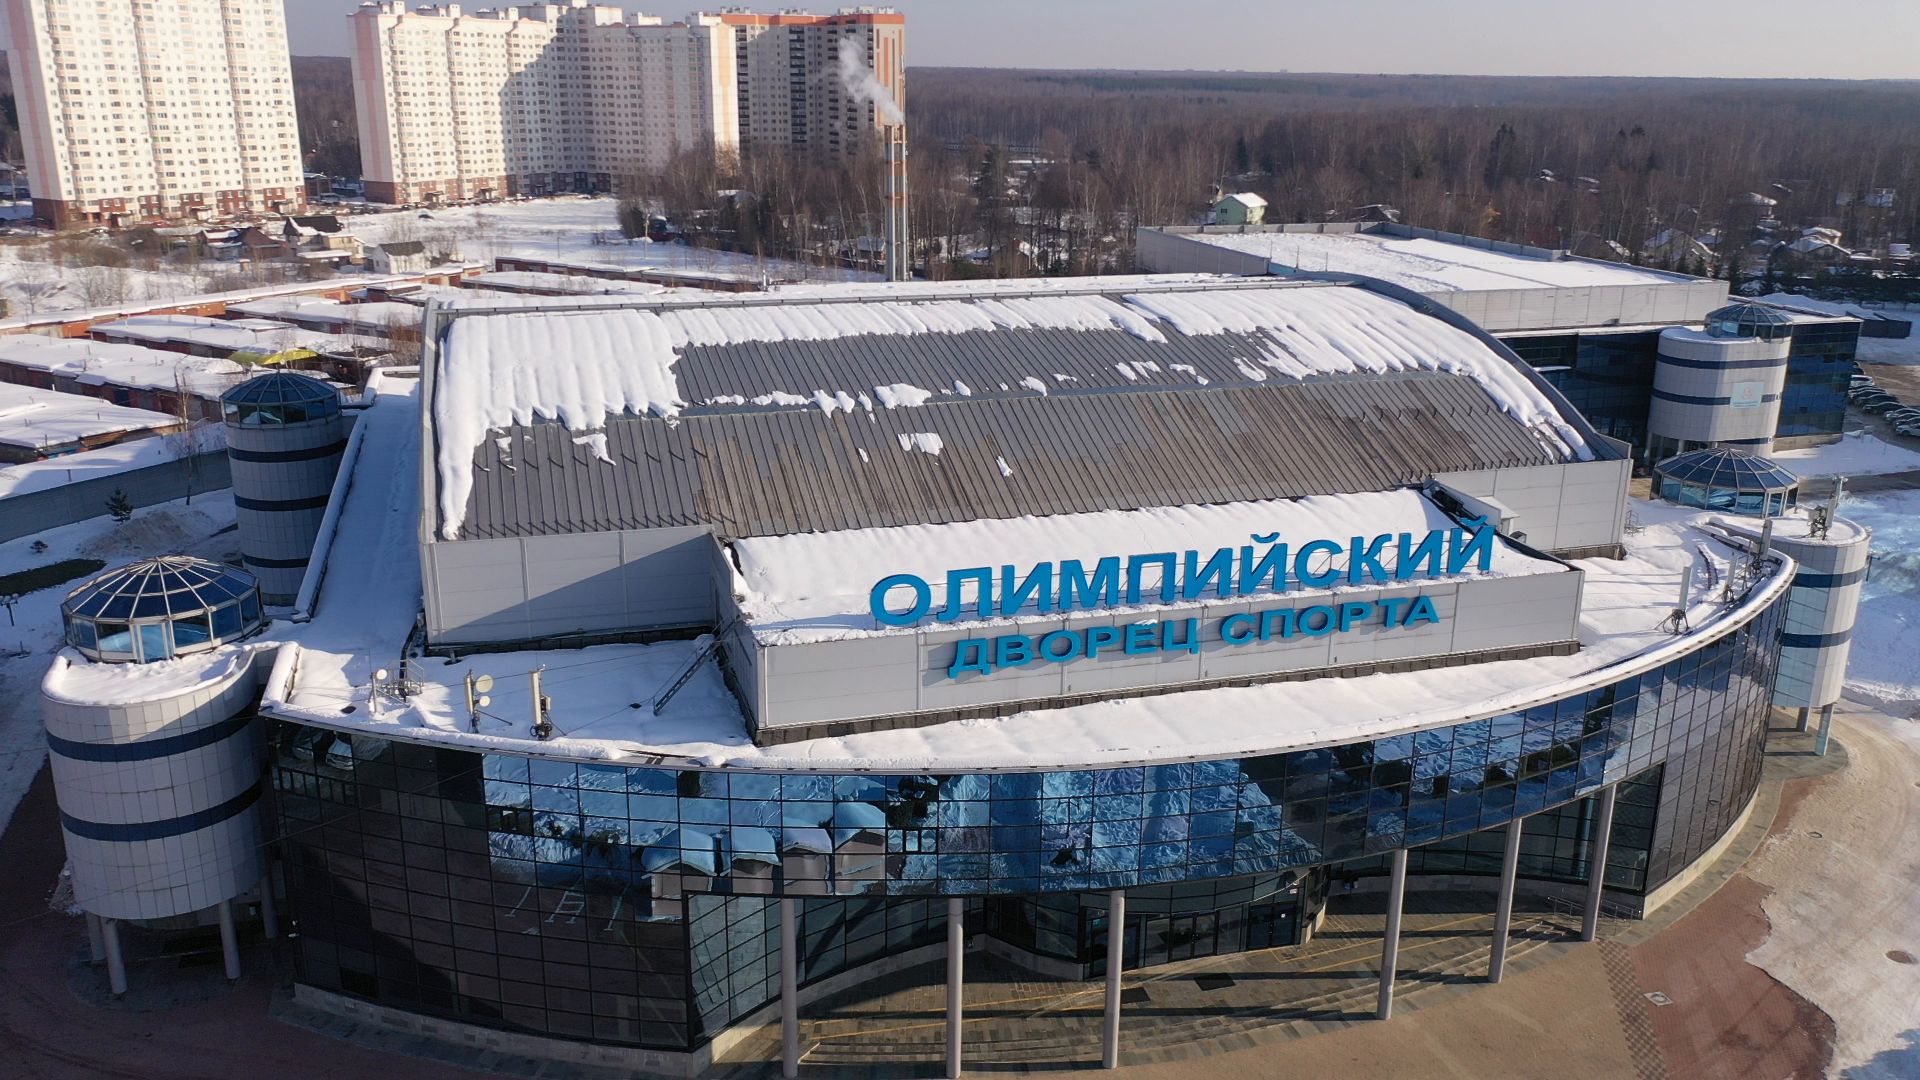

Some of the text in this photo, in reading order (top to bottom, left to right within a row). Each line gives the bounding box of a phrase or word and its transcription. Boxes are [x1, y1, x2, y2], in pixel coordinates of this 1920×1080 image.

[870, 515, 1497, 626] ОЛИМПИЙСКИЙ
[947, 596, 1440, 678] ДВОРЕЦ СПОРТА
